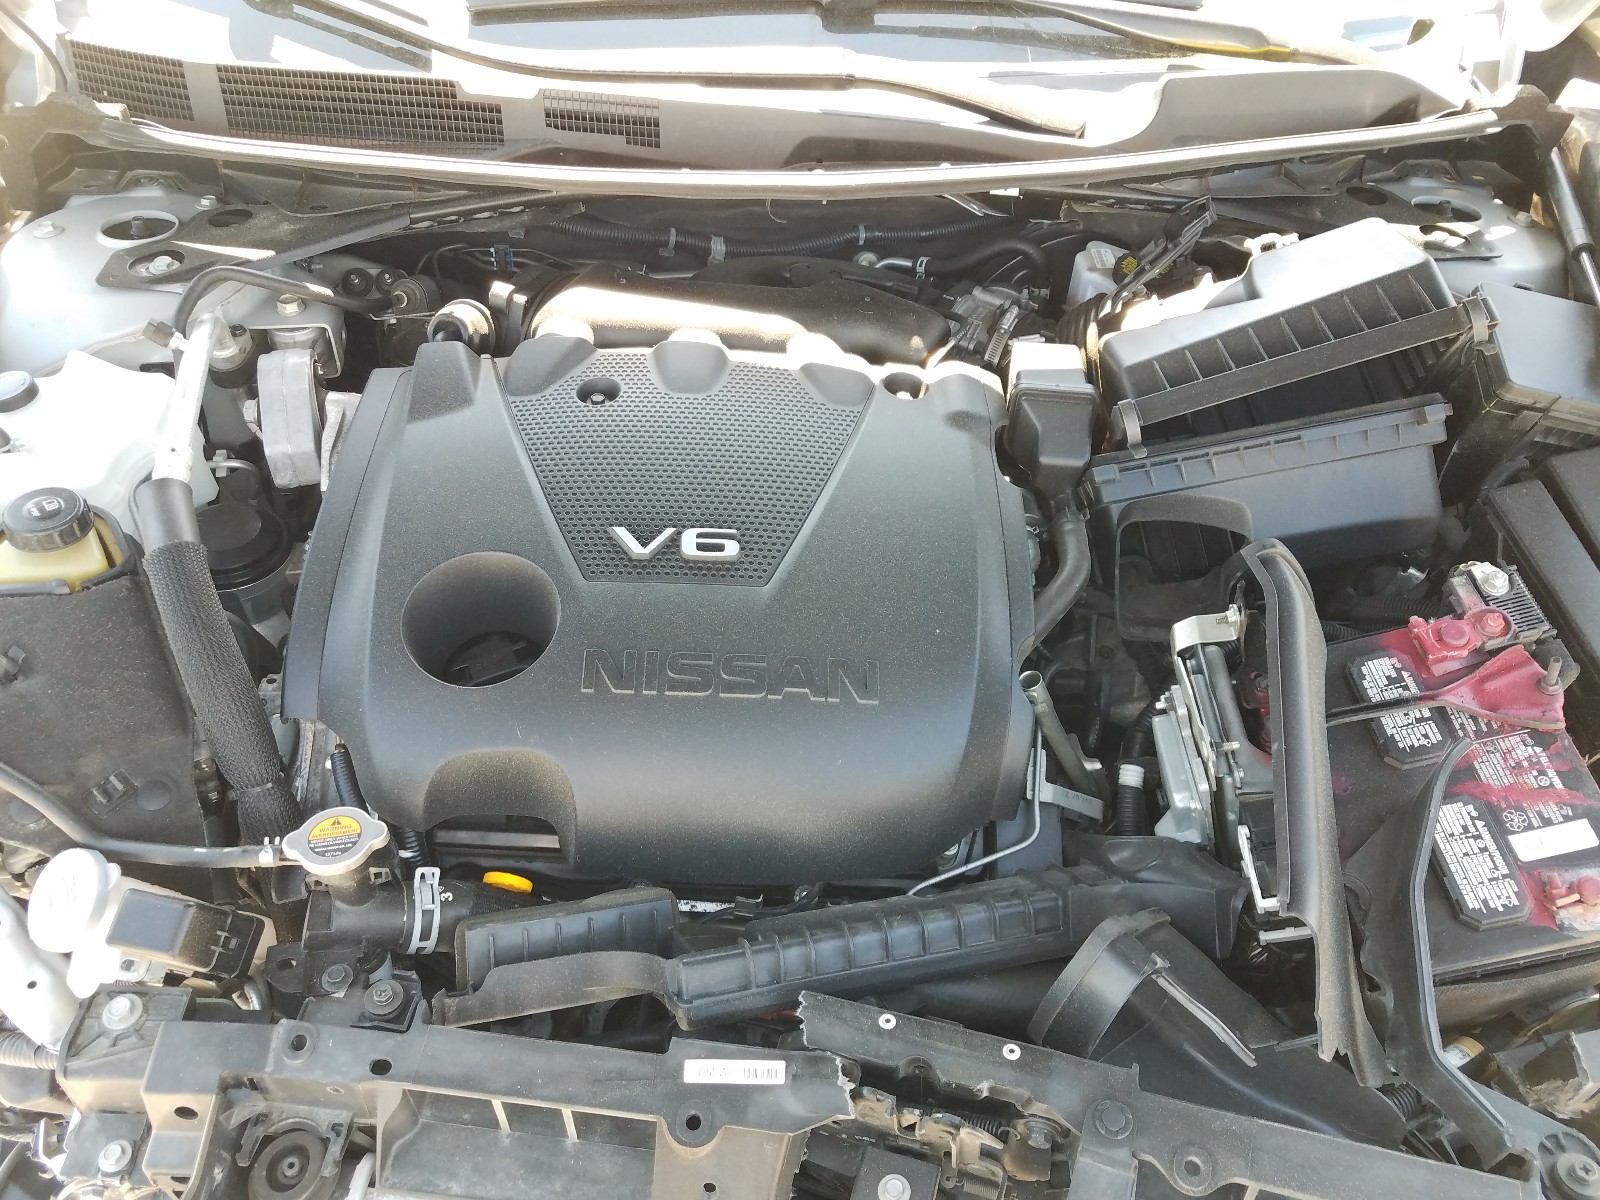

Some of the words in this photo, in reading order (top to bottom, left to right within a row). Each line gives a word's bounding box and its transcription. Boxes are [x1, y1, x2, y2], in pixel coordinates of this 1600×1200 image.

[606, 525, 741, 562] V6
[580, 648, 880, 705] NISSAN
[310, 828, 359, 839] AVERTISSEMENT
[319, 824, 353, 834] WARNING
[1478, 826, 1510, 876] DANGER/POISON
